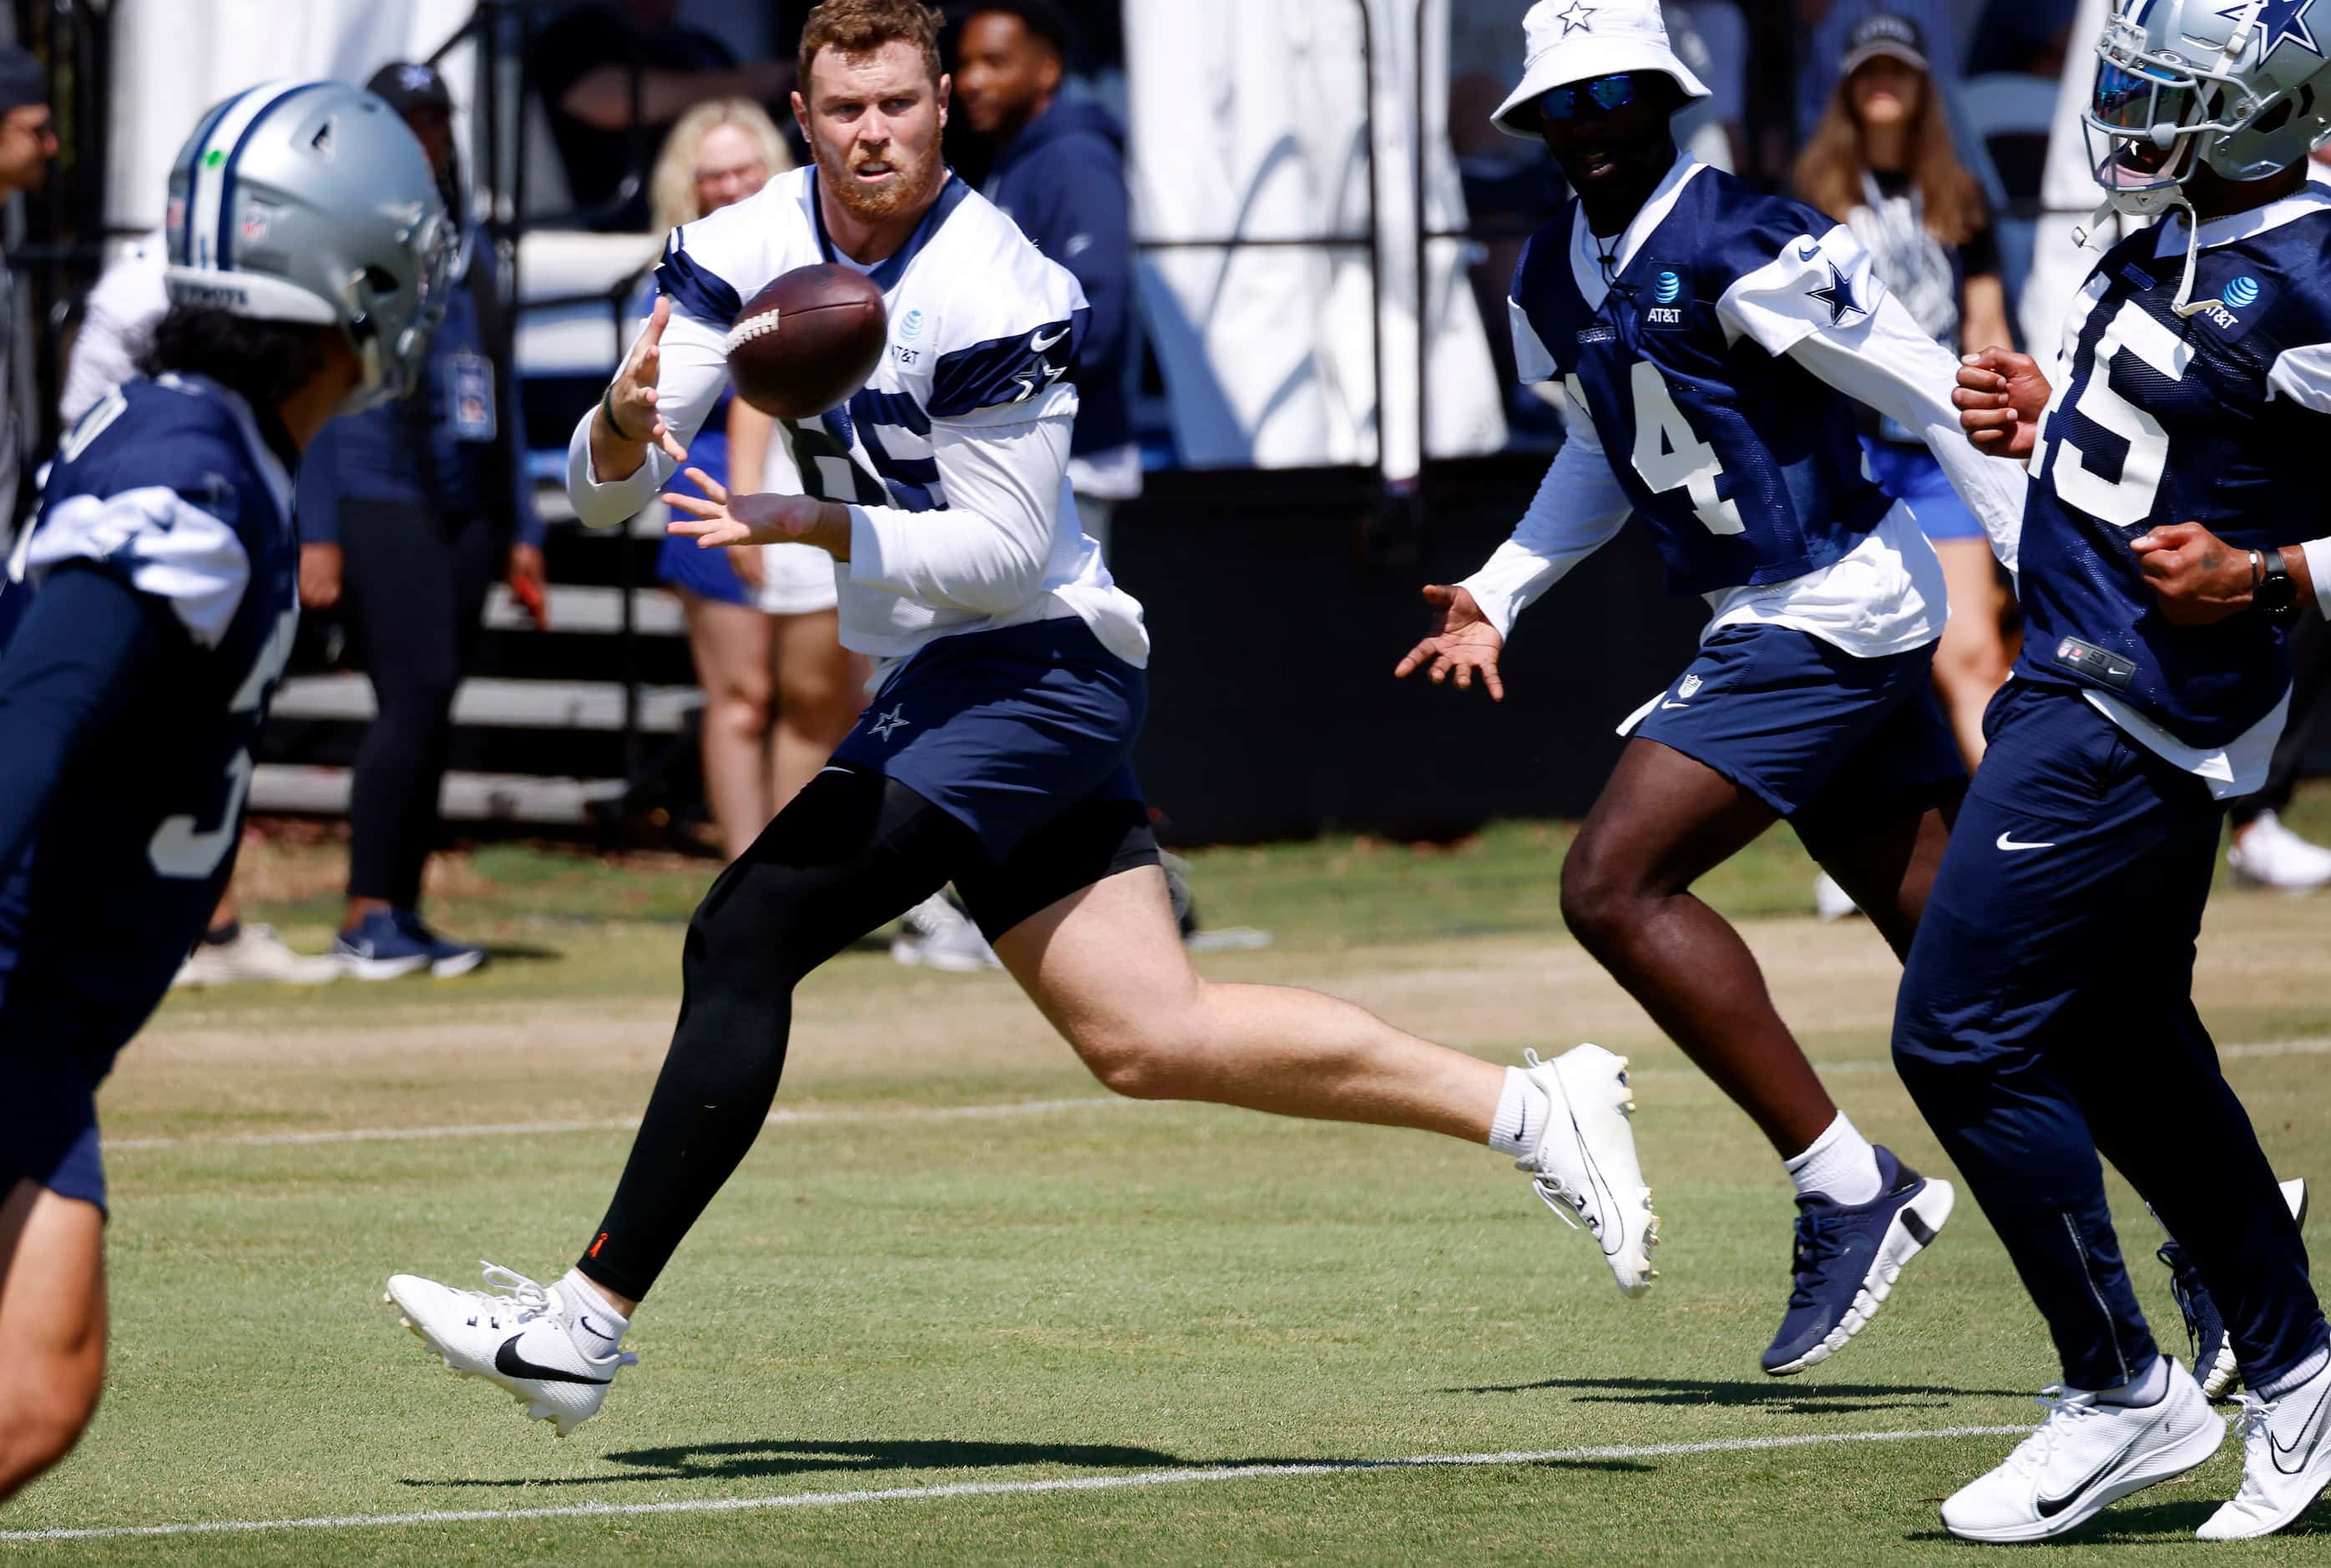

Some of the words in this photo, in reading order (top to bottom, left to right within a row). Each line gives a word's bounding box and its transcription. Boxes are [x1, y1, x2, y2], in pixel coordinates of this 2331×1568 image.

[1647, 307, 1682, 323] AT&T
[2205, 306, 2239, 329] T&T
[1565, 360, 1747, 535] 4
